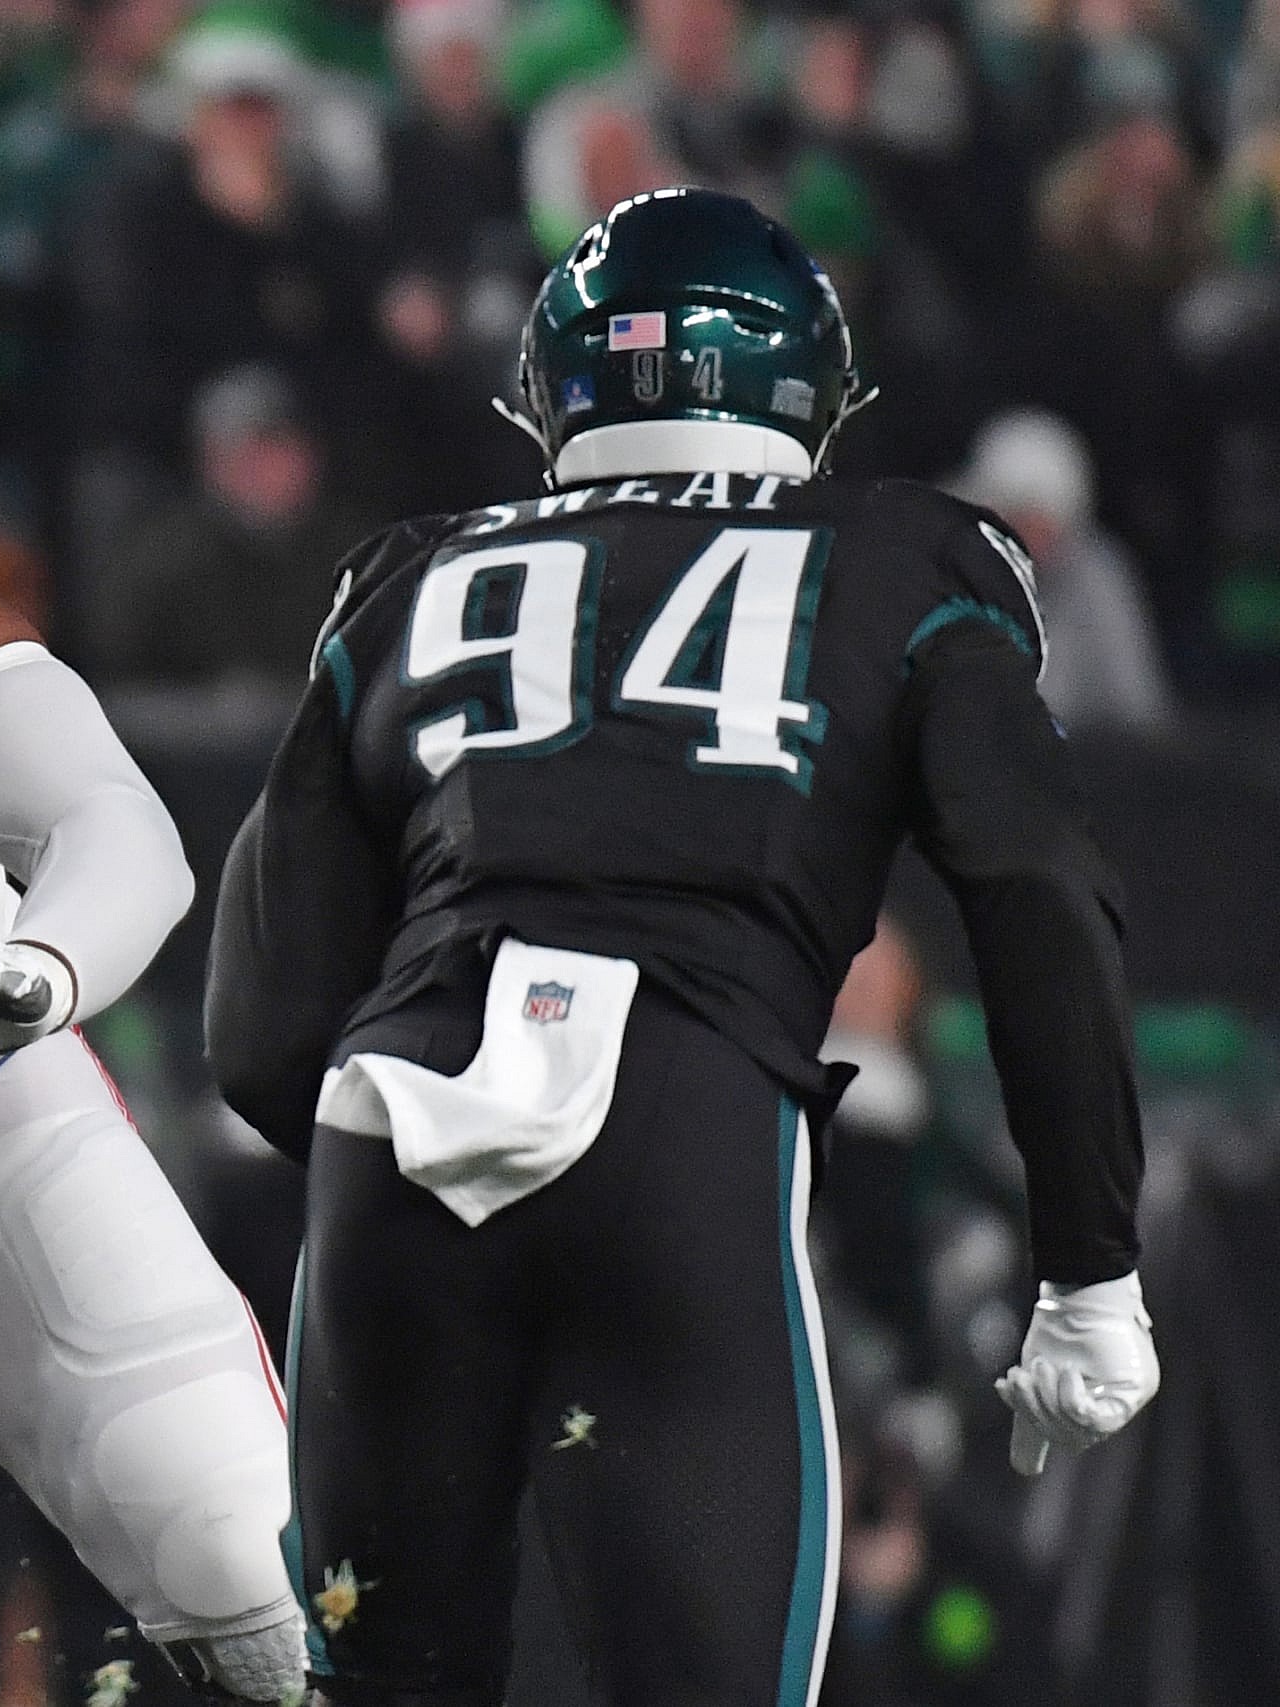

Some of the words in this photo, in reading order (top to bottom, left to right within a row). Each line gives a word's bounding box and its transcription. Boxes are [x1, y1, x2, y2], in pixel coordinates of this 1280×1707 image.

[632, 348, 725, 403] 94
[472, 471, 802, 535] SWEAT
[403, 525, 824, 786] 94
[528, 999, 567, 1022] NFL
